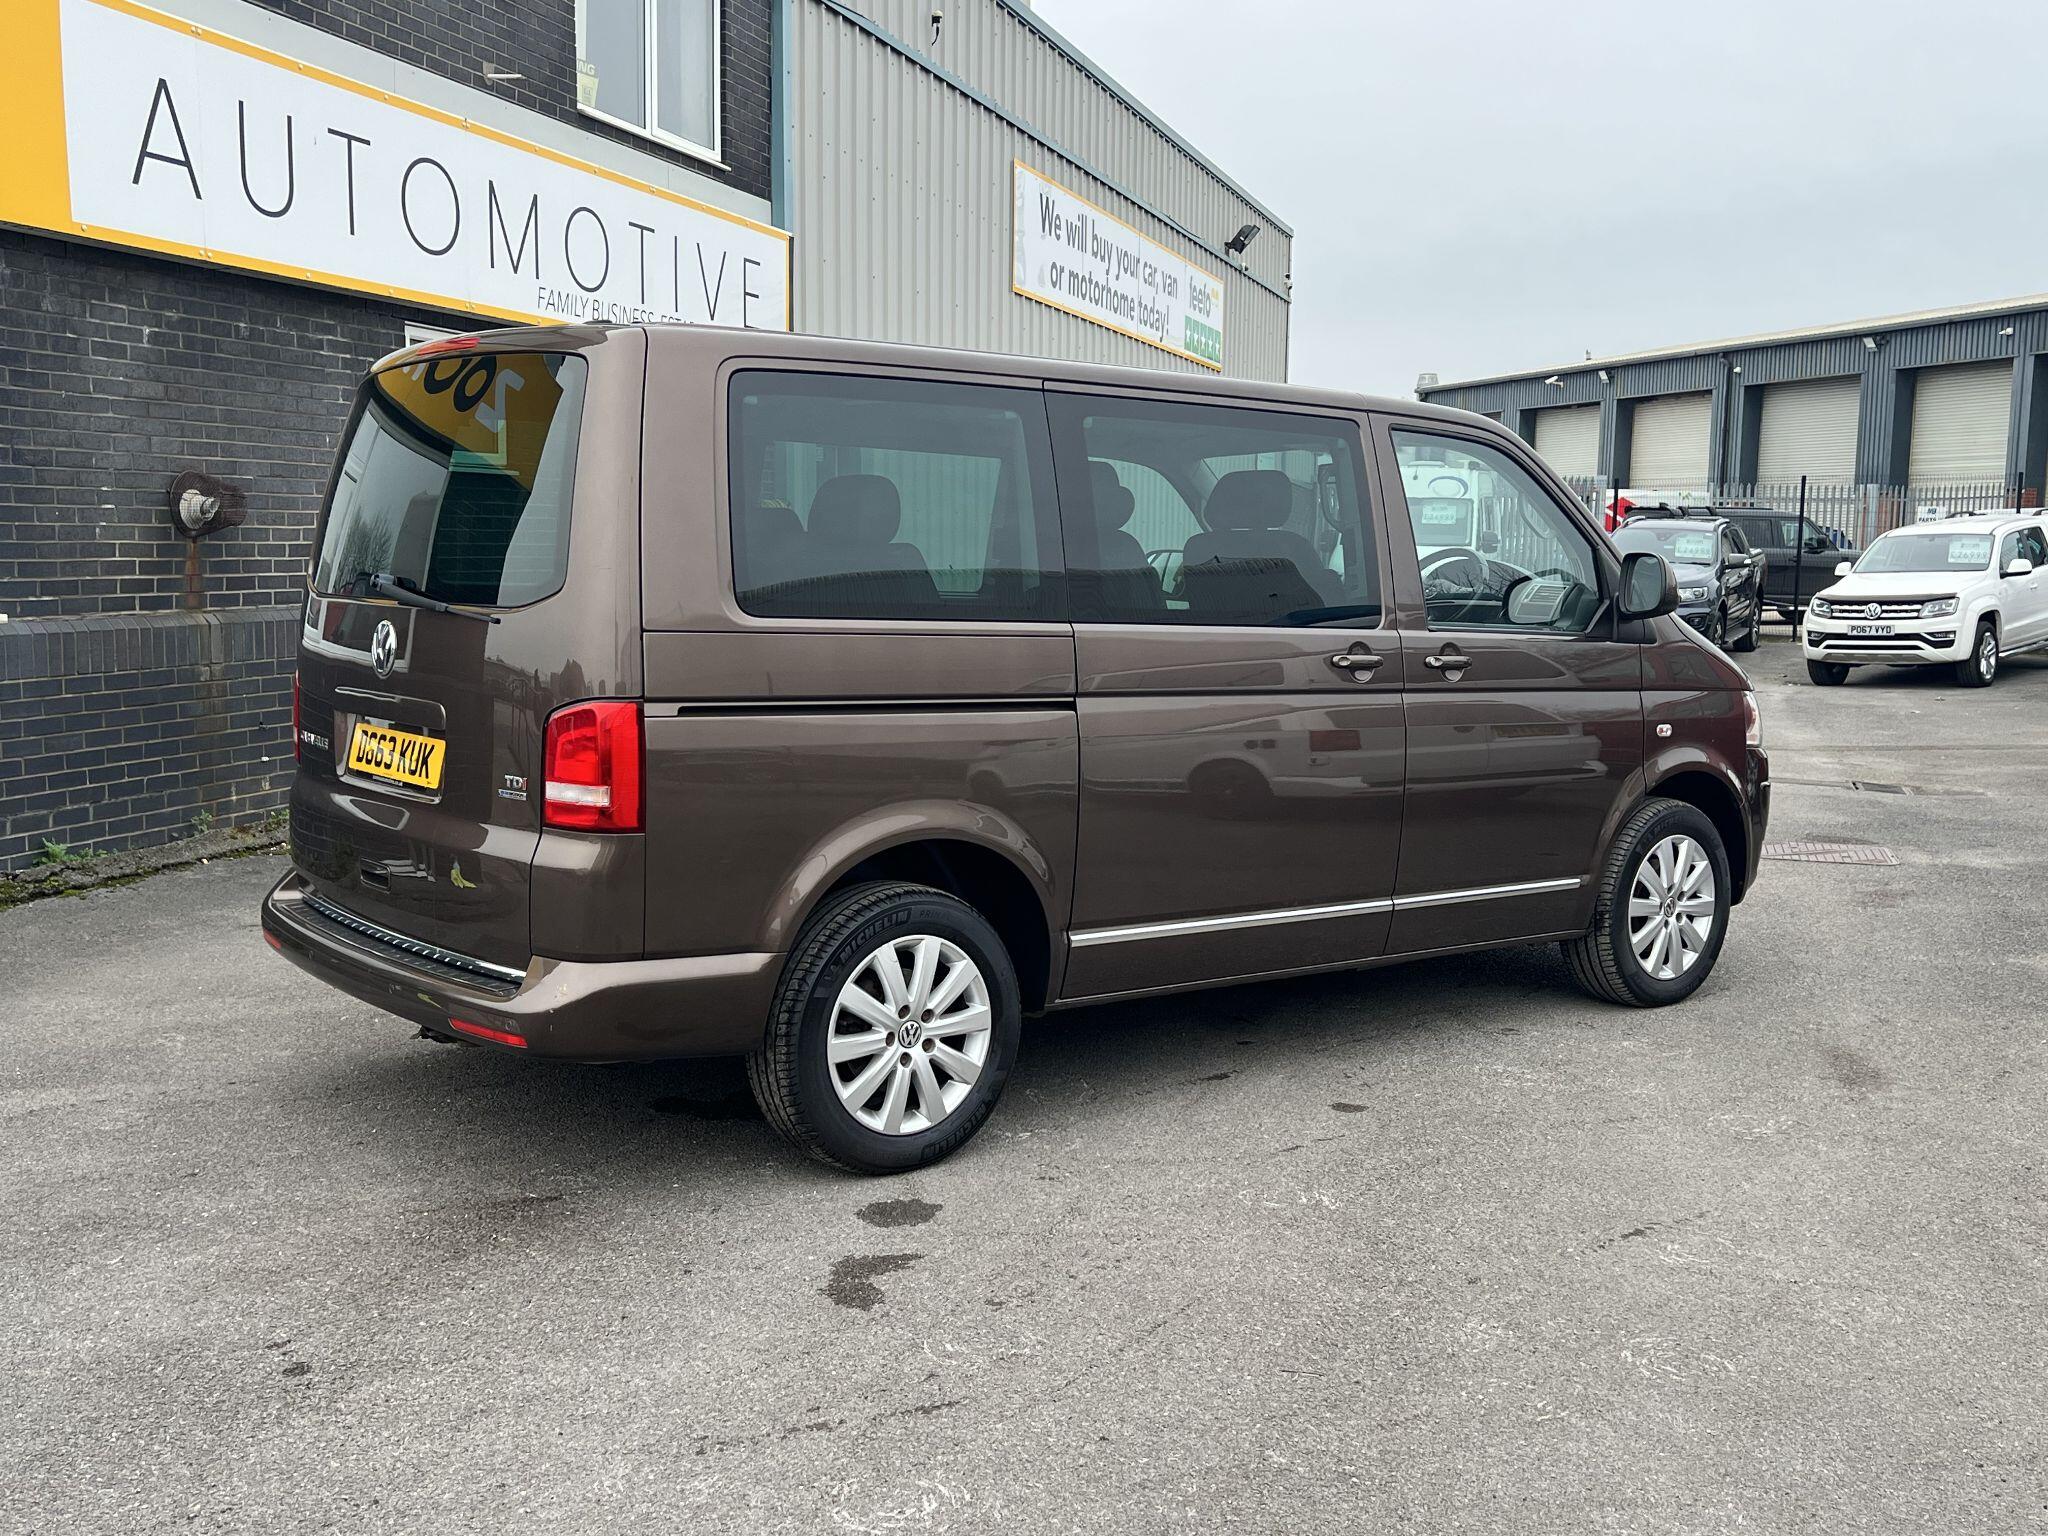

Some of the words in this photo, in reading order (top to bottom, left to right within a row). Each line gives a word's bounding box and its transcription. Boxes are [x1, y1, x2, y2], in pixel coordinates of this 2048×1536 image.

[132, 77, 761, 328] AUTOMOTIVE
[1039, 192, 1062, 241] We
[1066, 213, 1087, 254] will
[1091, 219, 1113, 276] buy
[1116, 245, 1141, 281] your
[1142, 260, 1159, 295] car,
[1161, 270, 1179, 300] van
[537, 286, 590, 318] FAMILY
[1050, 260, 1065, 291] or
[1068, 267, 1135, 321] motorhome
[1138, 294, 1170, 343] today!
[1188, 275, 1212, 318] feefo
[1850, 625, 1872, 634] PO67
[1875, 625, 1892, 634] VYD
[397, 737, 436, 780] KUK
[839, 909, 910, 965] MICHELIN
